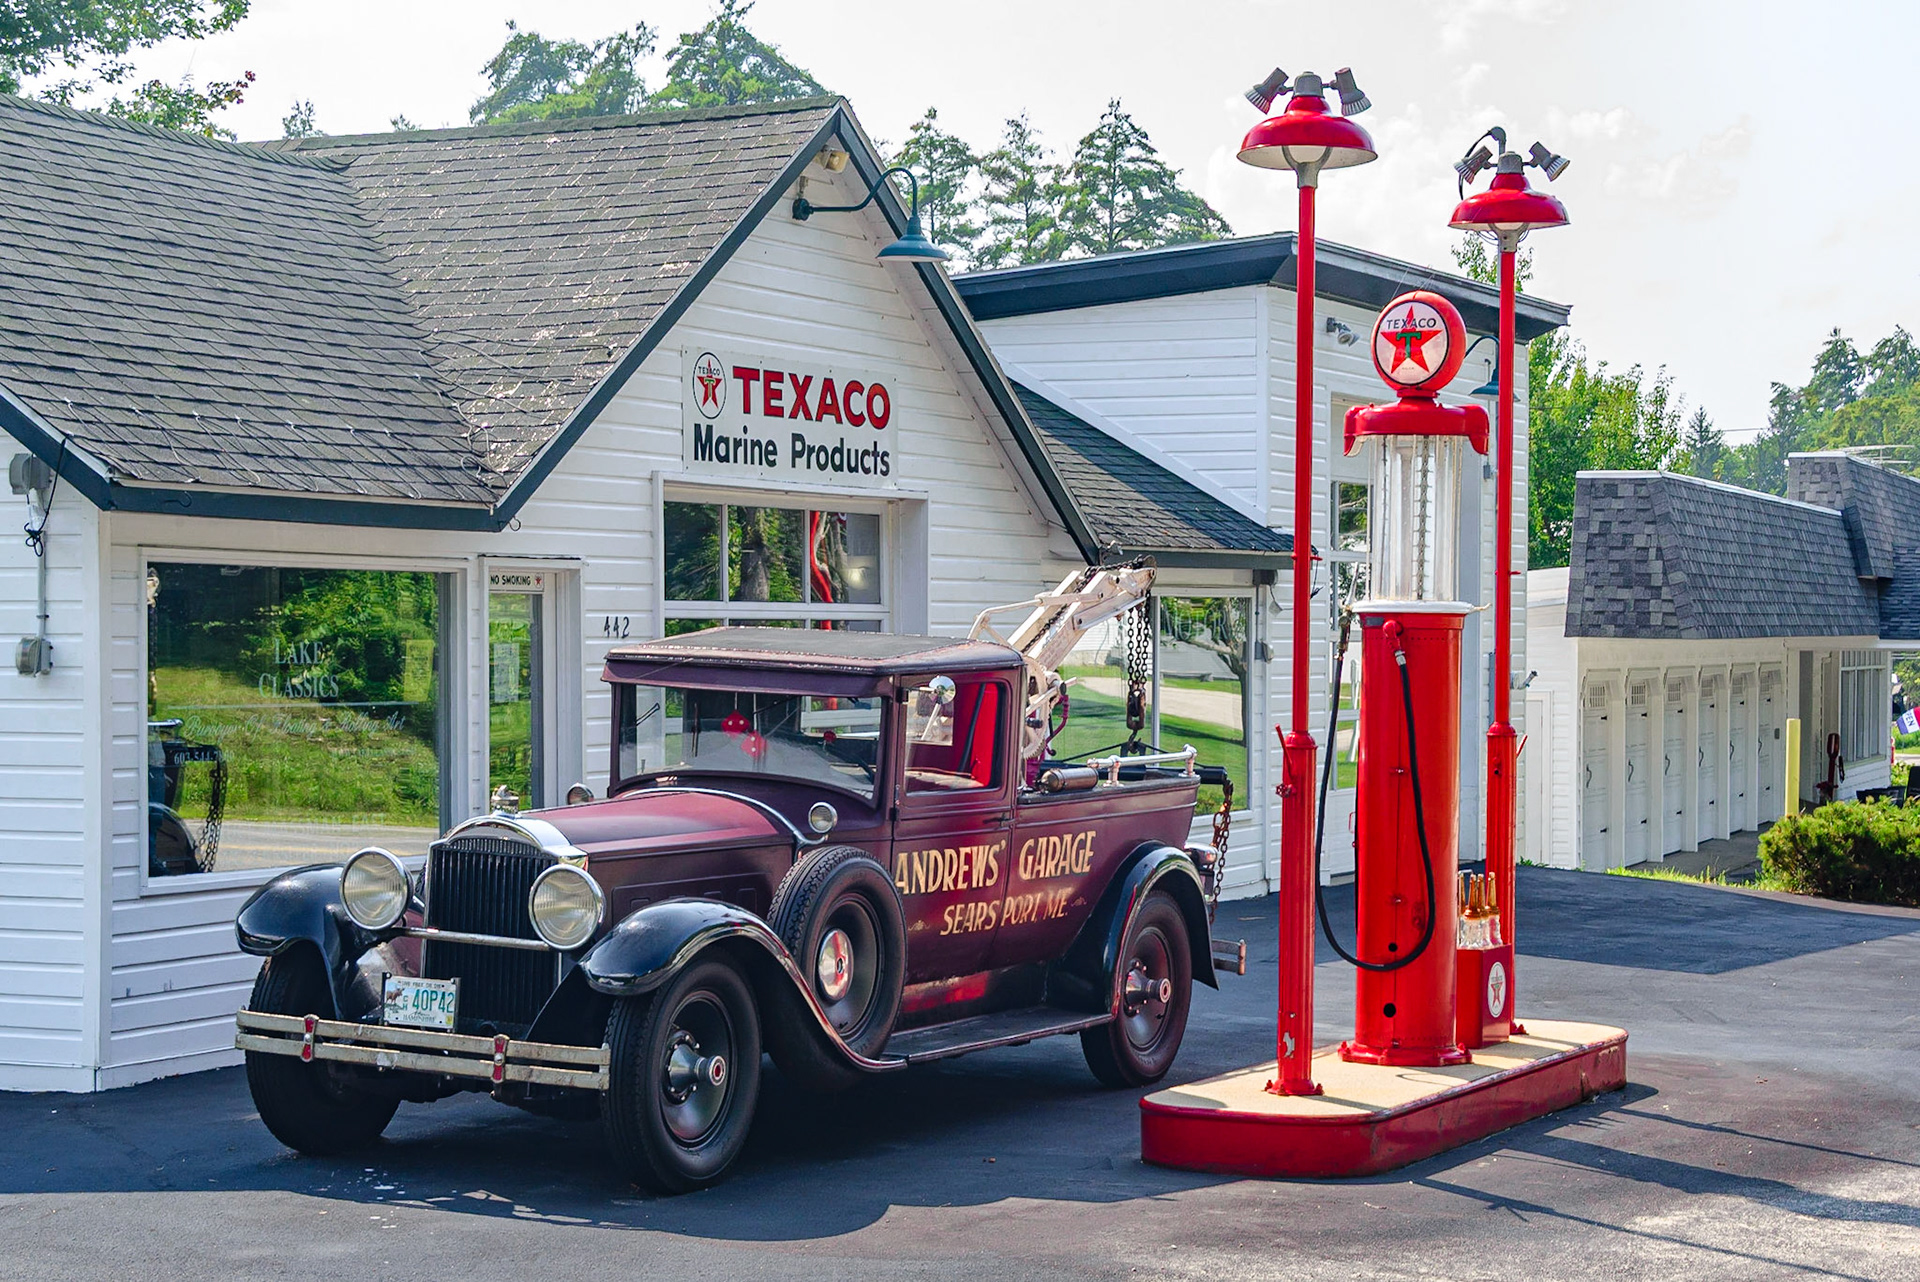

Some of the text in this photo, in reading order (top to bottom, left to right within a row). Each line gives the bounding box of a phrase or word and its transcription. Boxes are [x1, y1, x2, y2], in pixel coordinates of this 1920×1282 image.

[1387, 317, 1437, 329] TEXACO
[698, 366, 720, 376] TEXACO
[732, 365, 891, 430] TEXACO
[694, 423, 890, 476] Marine Products
[490, 575, 531, 586] NO SMOKING
[604, 616, 630, 639] 442
[274, 638, 323, 665] LAKE
[258, 673, 339, 699] CLASSICS
[1019, 831, 1096, 880] GARAGE
[412, 989, 455, 1014] 40P42
